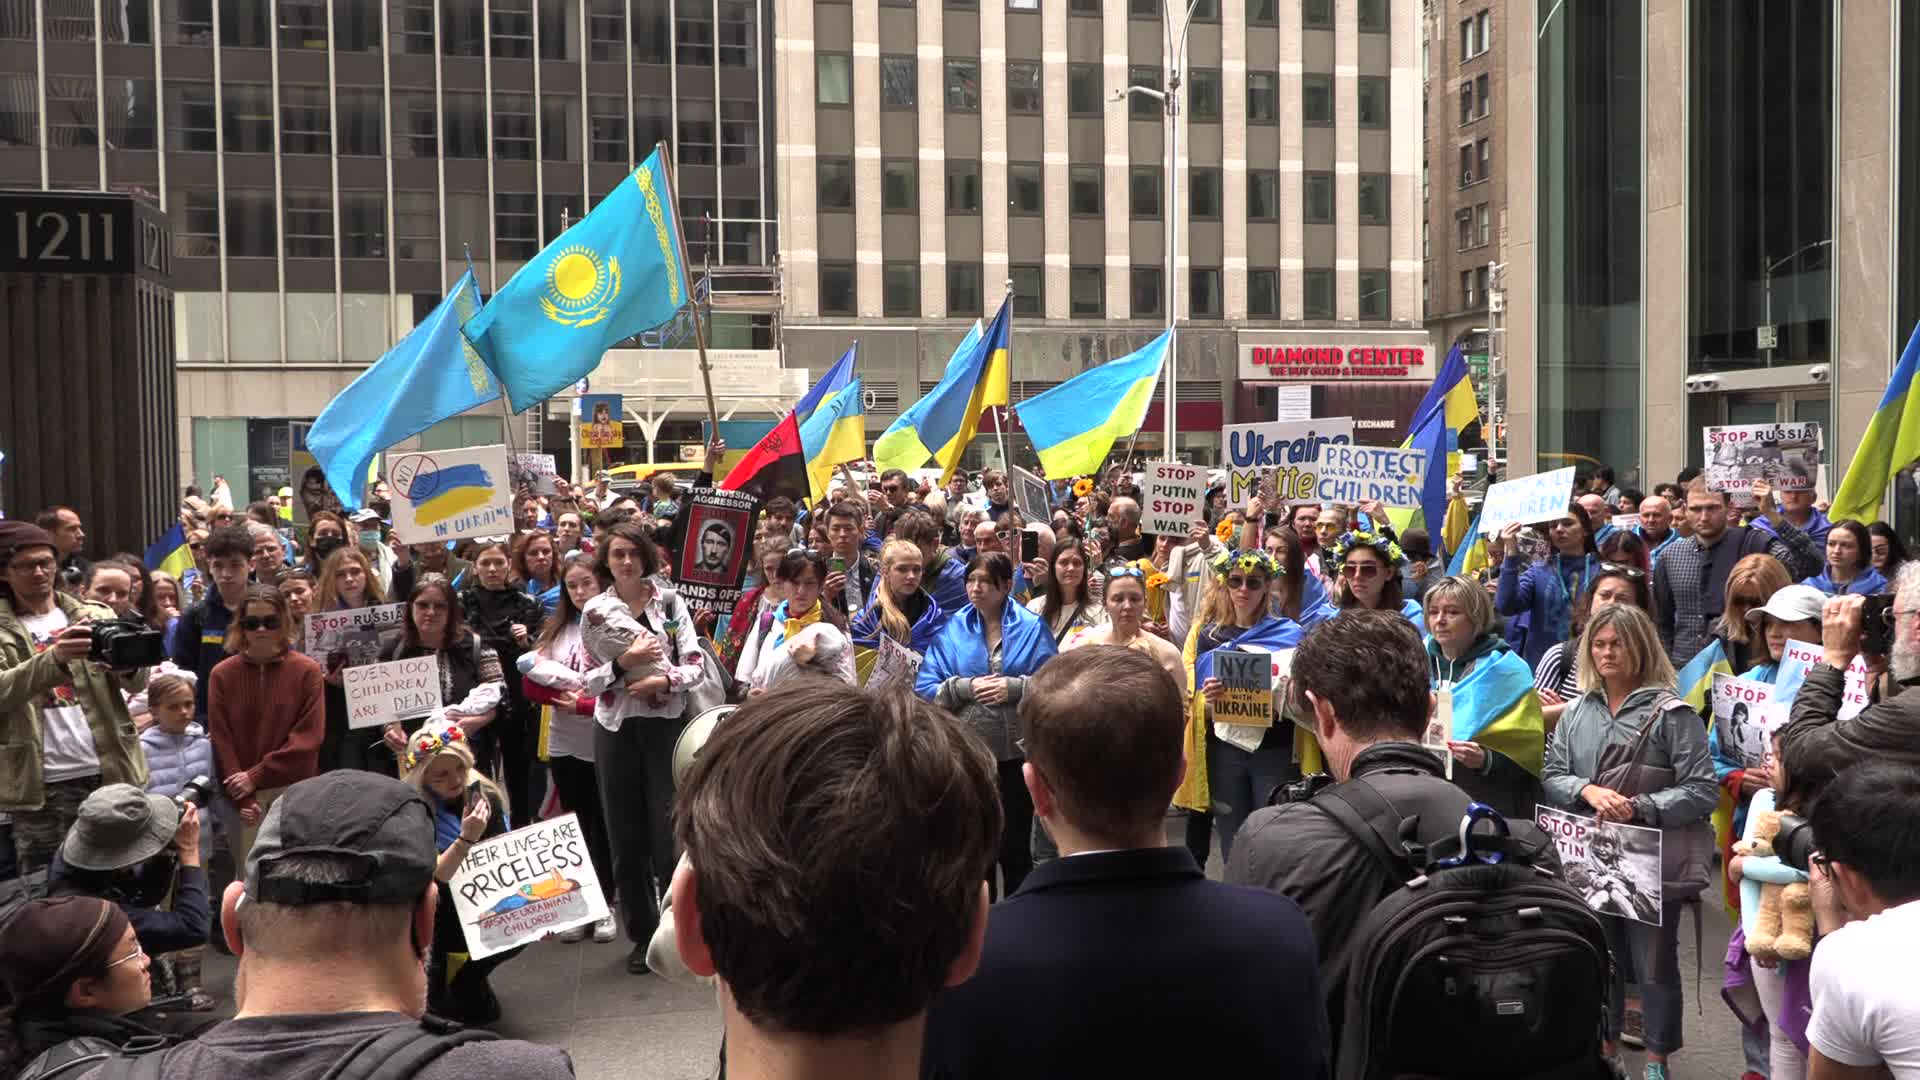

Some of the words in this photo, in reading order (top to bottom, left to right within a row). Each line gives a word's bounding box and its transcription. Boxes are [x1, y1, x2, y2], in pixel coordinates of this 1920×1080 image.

[16, 211, 113, 260] 1211
[139, 217, 172, 275] 1211
[1252, 347, 1344, 365] DIAMOND
[1349, 347, 1425, 365] CENTER
[1270, 366, 1287, 376] WE
[1311, 366, 1340, 376] GOLD
[1357, 420, 1396, 429] EXCHANGE
[1709, 431, 1748, 443] STOP
[1755, 429, 1812, 441] RUSSIA
[1326, 447, 1427, 474] PROTECT
[1157, 467, 1196, 481] STOP
[1320, 467, 1395, 480] UKRAINIAN
[687, 487, 714, 495] STOP
[1152, 484, 1197, 499] PUTIN
[1318, 478, 1423, 505] CHILDREN
[1719, 479, 1748, 489] STOP
[693, 495, 752, 510] AGGRESSOR
[1152, 501, 1195, 515] STOP
[434, 520, 448, 537] IN
[1153, 519, 1190, 534] WAR
[719, 589, 742, 601] OFF
[684, 598, 733, 613] KRAINE
[312, 616, 349, 632] STOP
[348, 663, 391, 682] OVER
[400, 661, 430, 675] 100
[1220, 655, 1263, 677] NYC
[351, 677, 428, 700] CHILDREN
[1724, 683, 1767, 704] STOP
[352, 703, 380, 720] ARE
[393, 691, 437, 712] DEAD
[1214, 700, 1271, 719] UKRAINE
[1540, 815, 1586, 839] STOP
[504, 830, 550, 858] LIVES
[553, 821, 578, 844] ARE
[459, 841, 583, 907] PRICELESS
[484, 910, 520, 928] #SAVE
[520, 894, 573, 917] UKRAINIAN
[503, 911, 559, 937] CHILDREN
